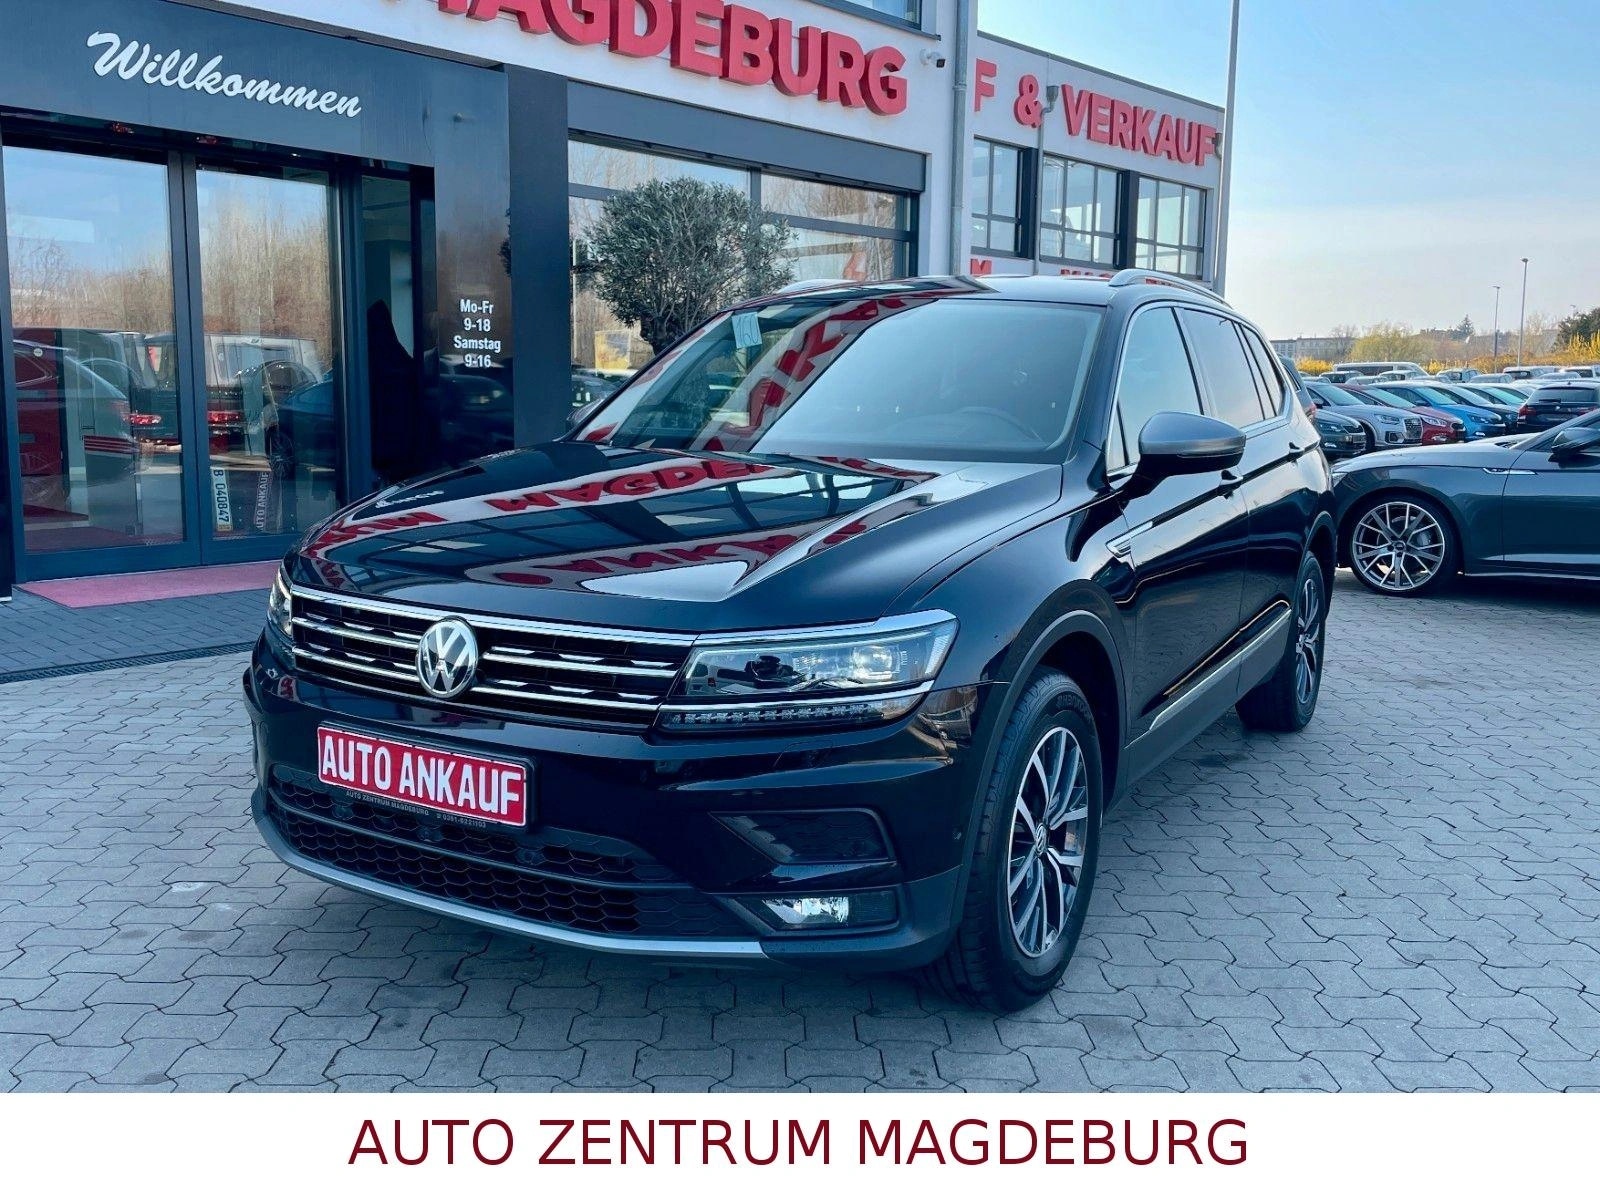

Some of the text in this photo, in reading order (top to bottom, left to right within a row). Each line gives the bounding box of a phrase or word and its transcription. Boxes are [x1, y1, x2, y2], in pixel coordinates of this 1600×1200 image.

[87, 31, 362, 117] Willkommen
[1014, 75, 1041, 128] &
[1061, 84, 1217, 166] VERKAUF
[460, 299, 494, 314] Mo-Fr
[463, 317, 491, 332] 9-18
[453, 335, 501, 353] Samstag
[464, 353, 492, 368] 9-16
[321, 734, 522, 815] AUTO ANKAUF
